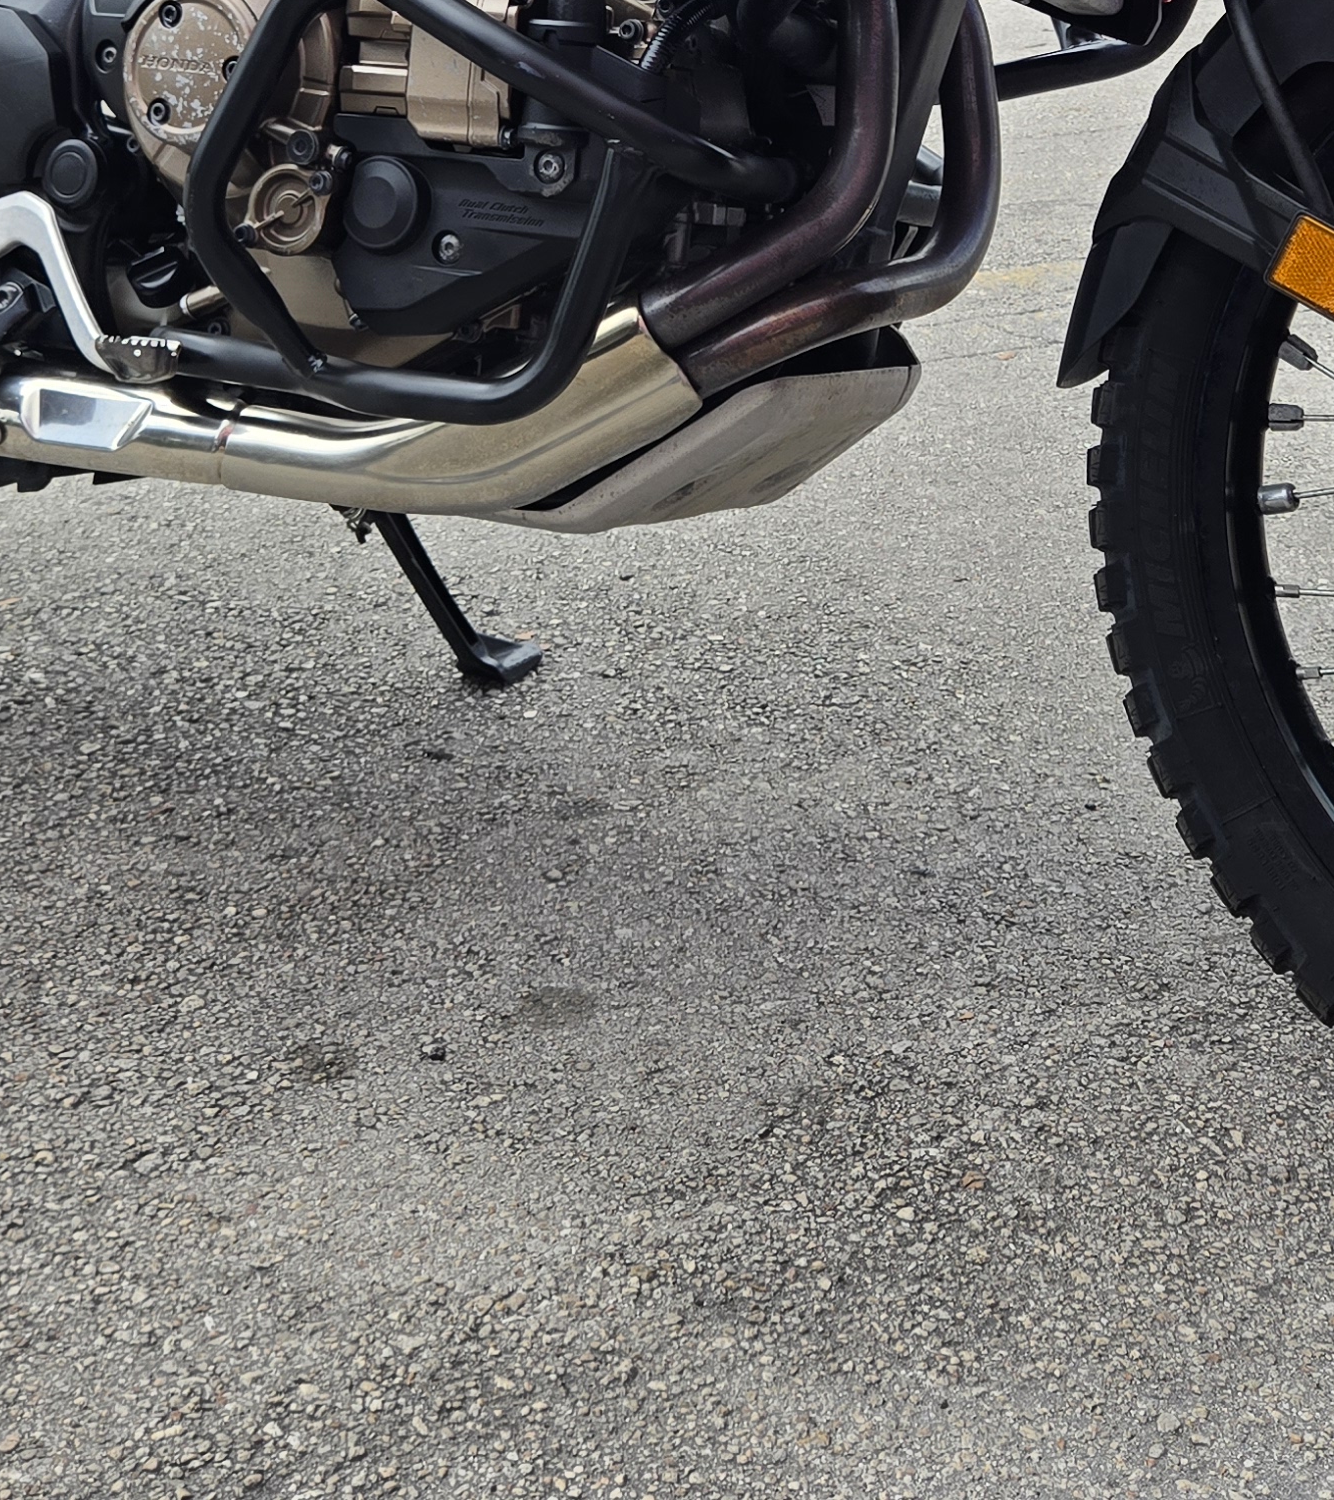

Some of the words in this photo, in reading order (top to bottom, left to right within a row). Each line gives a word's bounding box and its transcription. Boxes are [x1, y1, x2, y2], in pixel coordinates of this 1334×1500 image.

[139, 53, 217, 77] HONDA
[457, 198, 489, 210] Dual
[489, 201, 529, 215] Clutch
[461, 208, 545, 228] Transmission
[1137, 357, 1192, 638] MICHELIN
